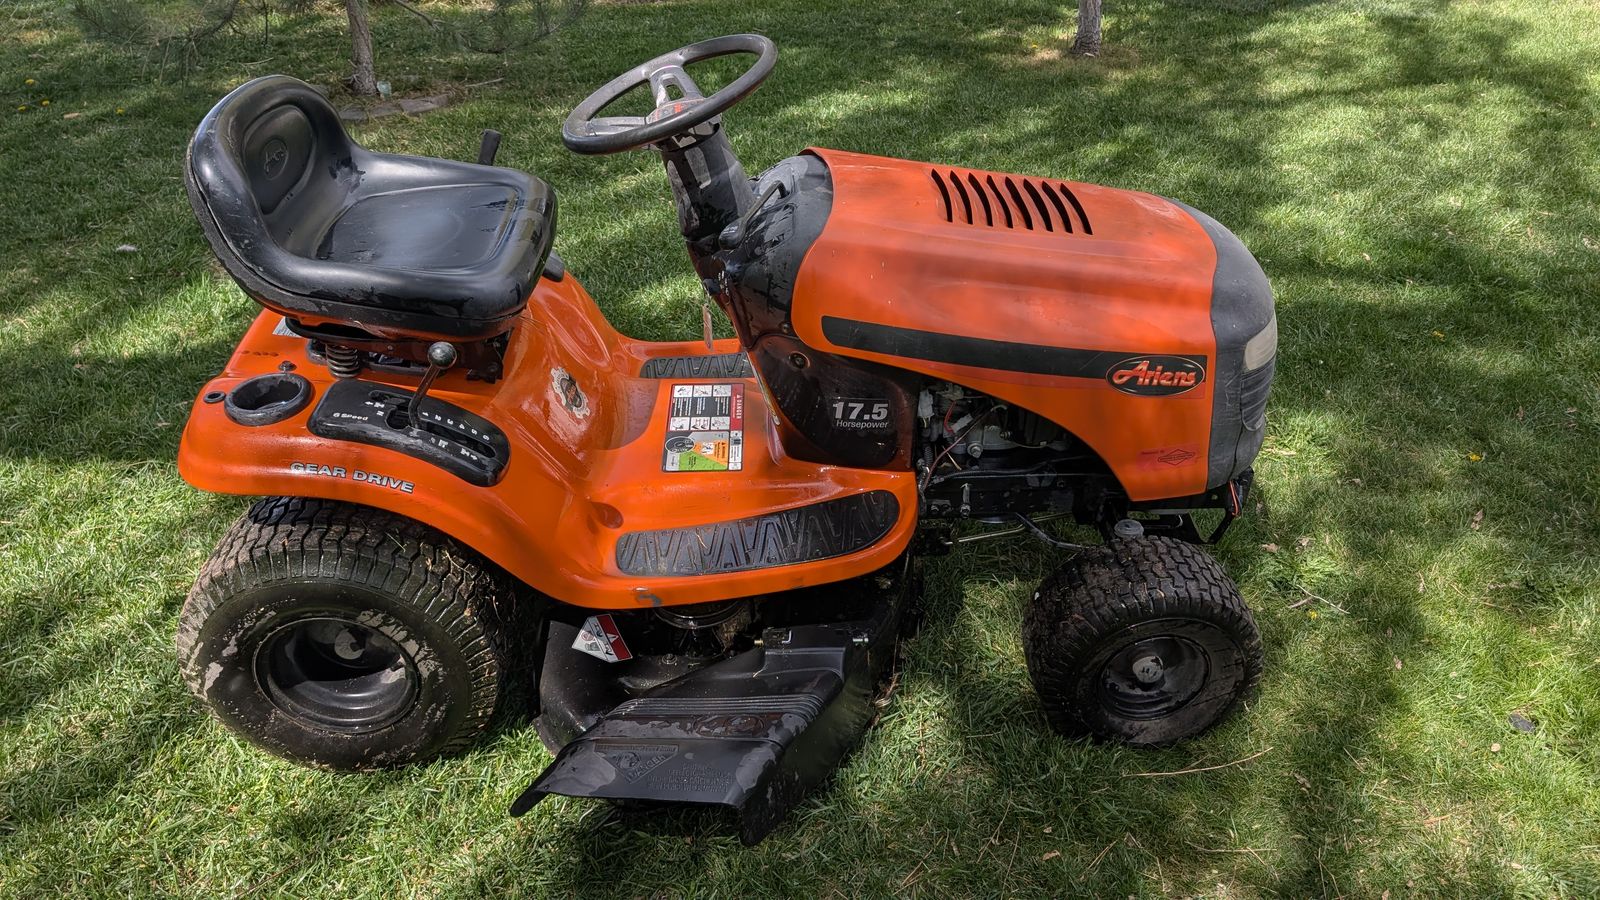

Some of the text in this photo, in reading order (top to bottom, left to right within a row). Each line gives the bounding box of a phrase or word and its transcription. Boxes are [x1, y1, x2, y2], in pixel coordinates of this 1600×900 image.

[1112, 360, 1197, 387] Ariens
[832, 401, 889, 420] 17.5
[836, 419, 889, 430] Horsepower
[290, 462, 415, 493] GEAR DRIVE
